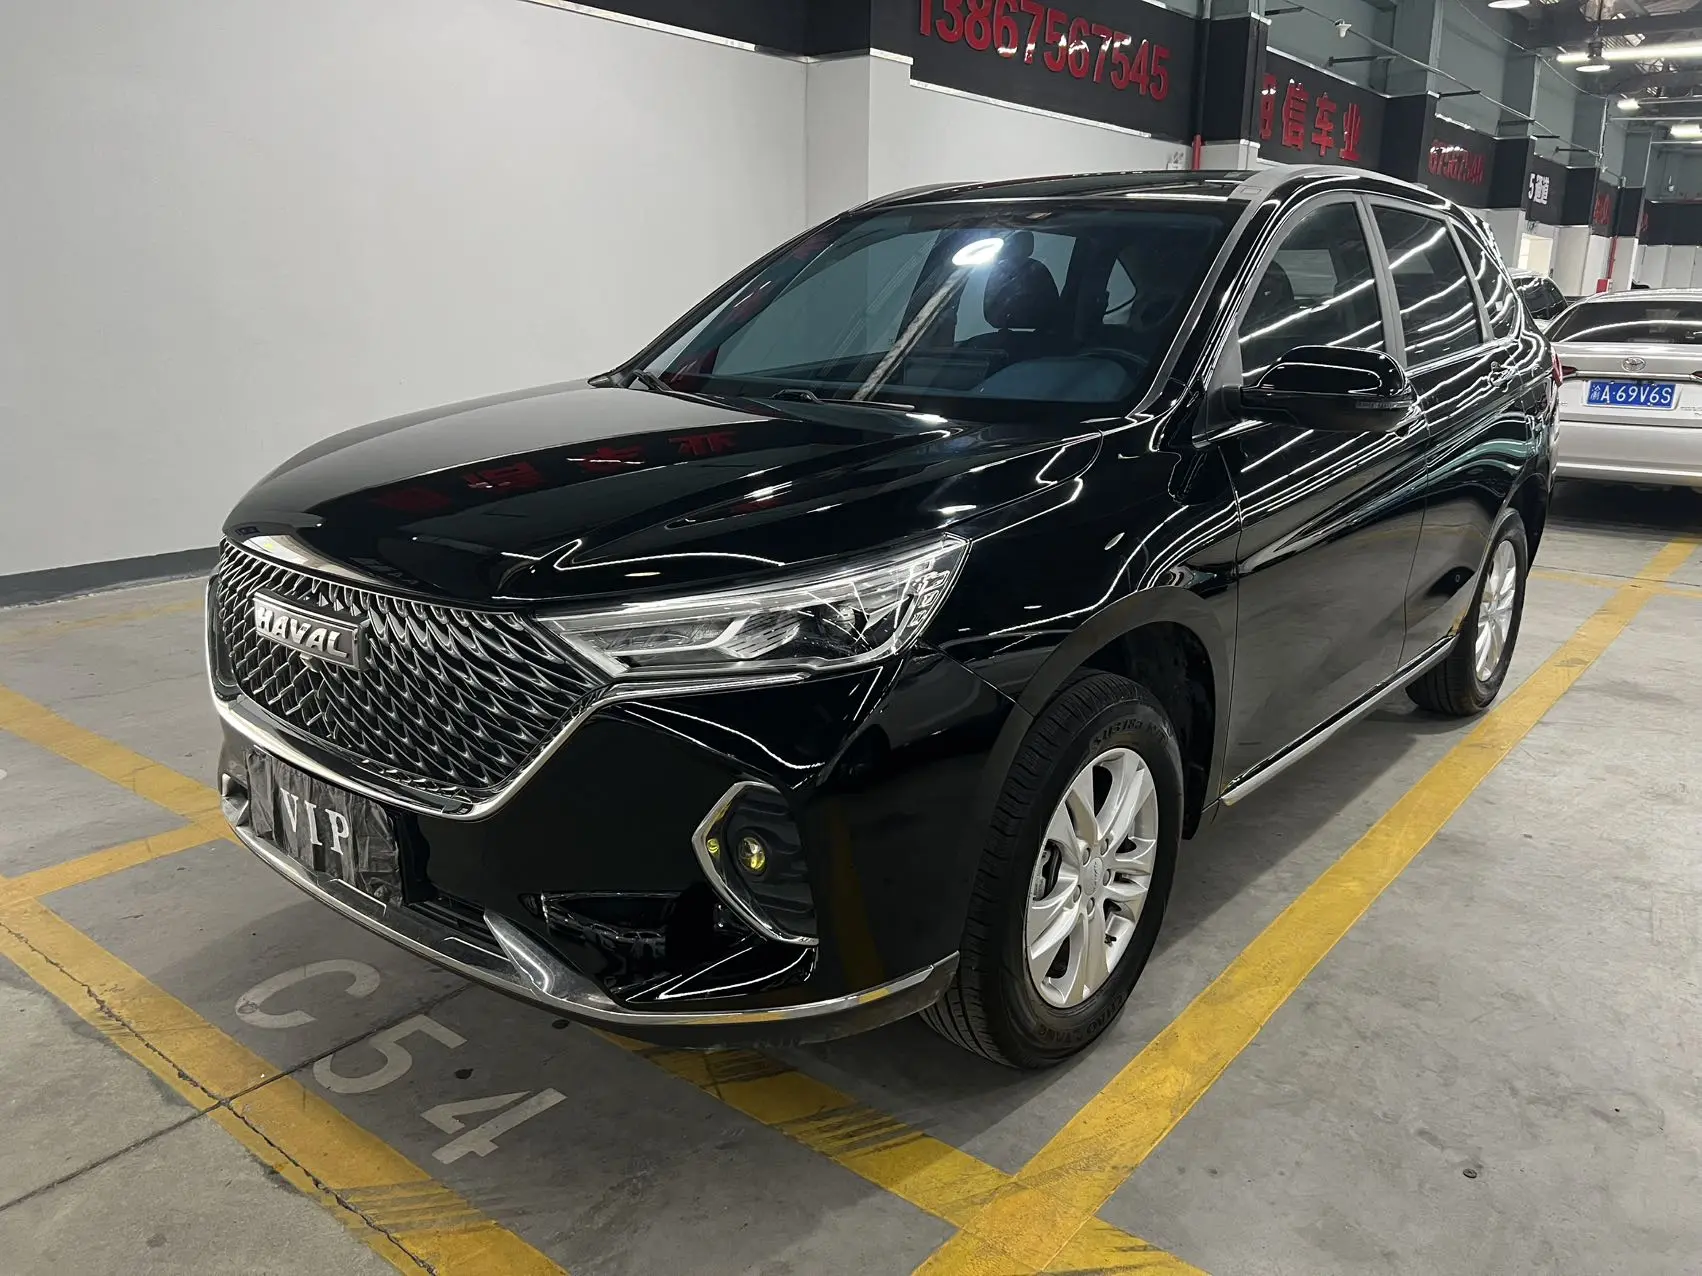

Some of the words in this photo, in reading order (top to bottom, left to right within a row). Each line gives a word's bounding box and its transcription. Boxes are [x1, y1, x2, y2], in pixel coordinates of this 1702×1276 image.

[917, 0, 1172, 100] 13867567545
[255, 606, 349, 659] HAVAL
[279, 787, 350, 856] VIP
